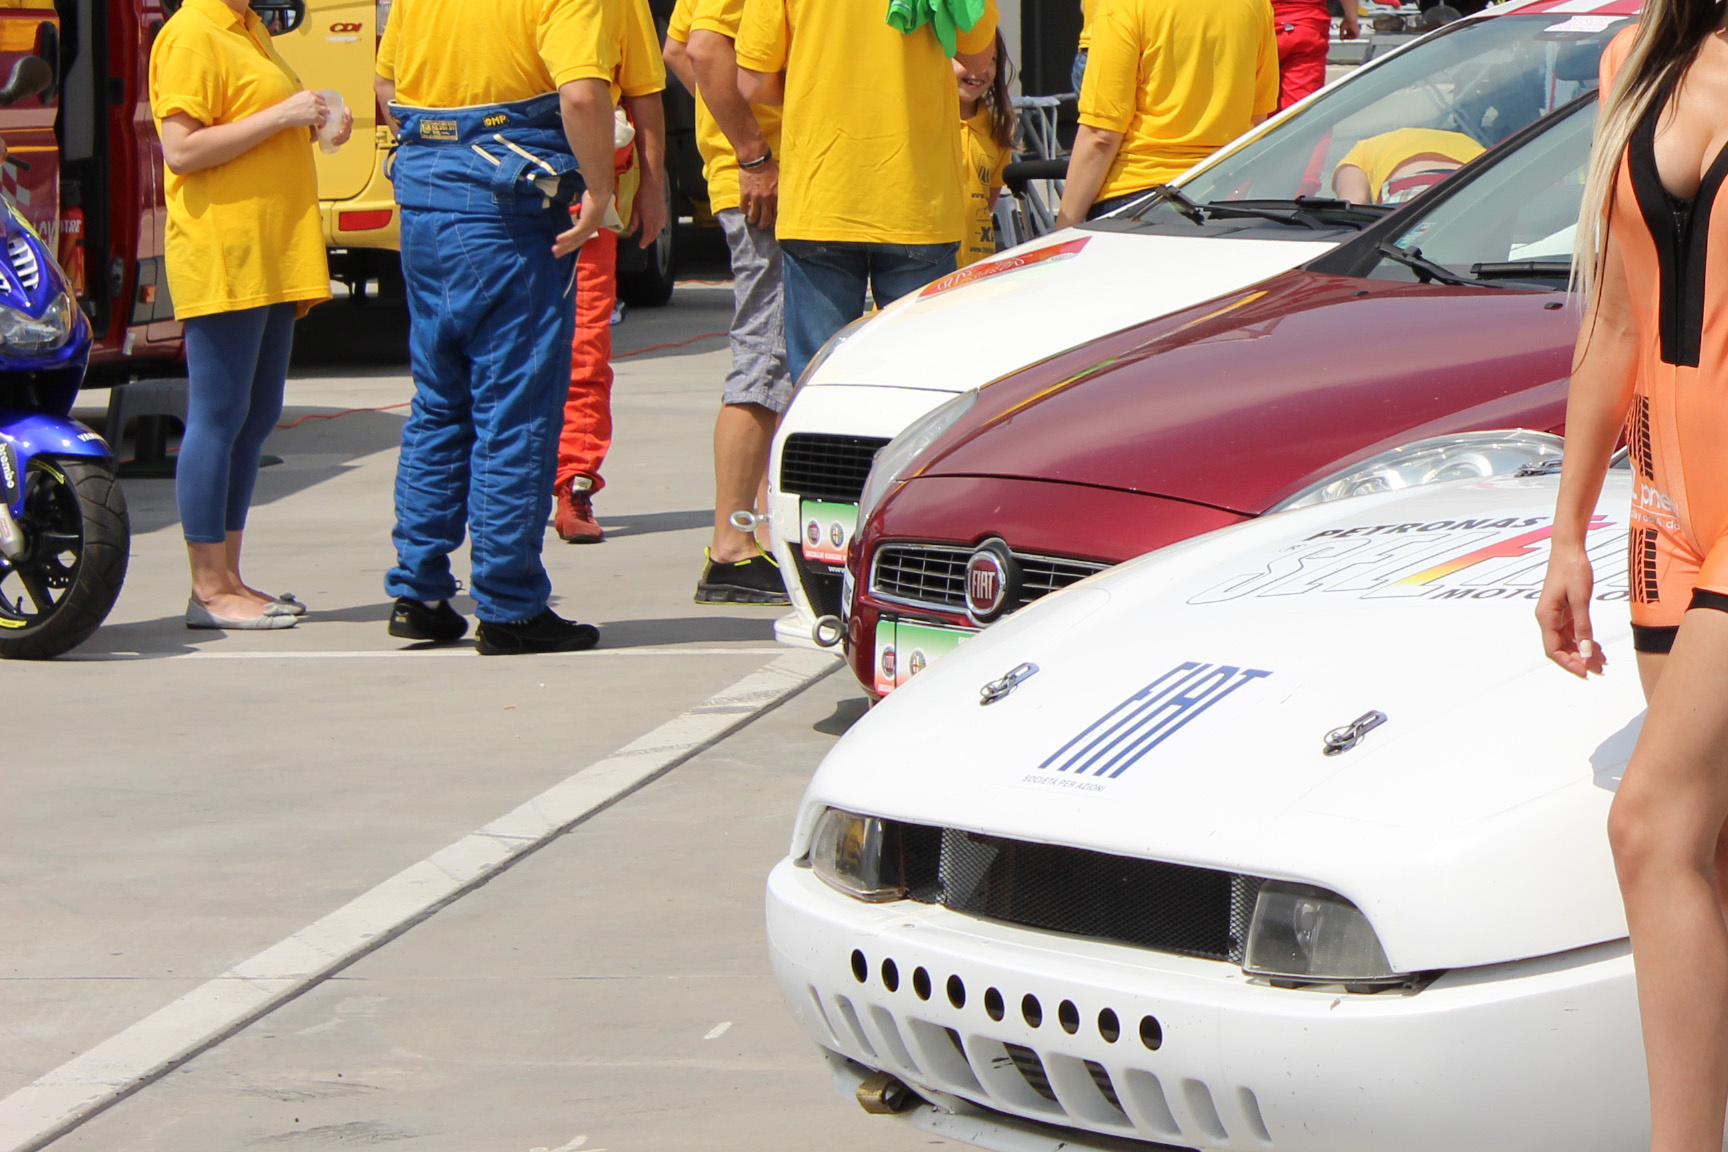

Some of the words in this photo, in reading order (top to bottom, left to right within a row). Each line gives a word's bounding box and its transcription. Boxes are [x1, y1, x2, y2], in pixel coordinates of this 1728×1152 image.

[329, 22, 363, 34] CDI
[484, 114, 507, 127] OMP
[1302, 515, 1550, 542] PETRONAS
[972, 570, 996, 600] FIAT
[1036, 661, 1275, 779] FIAT
